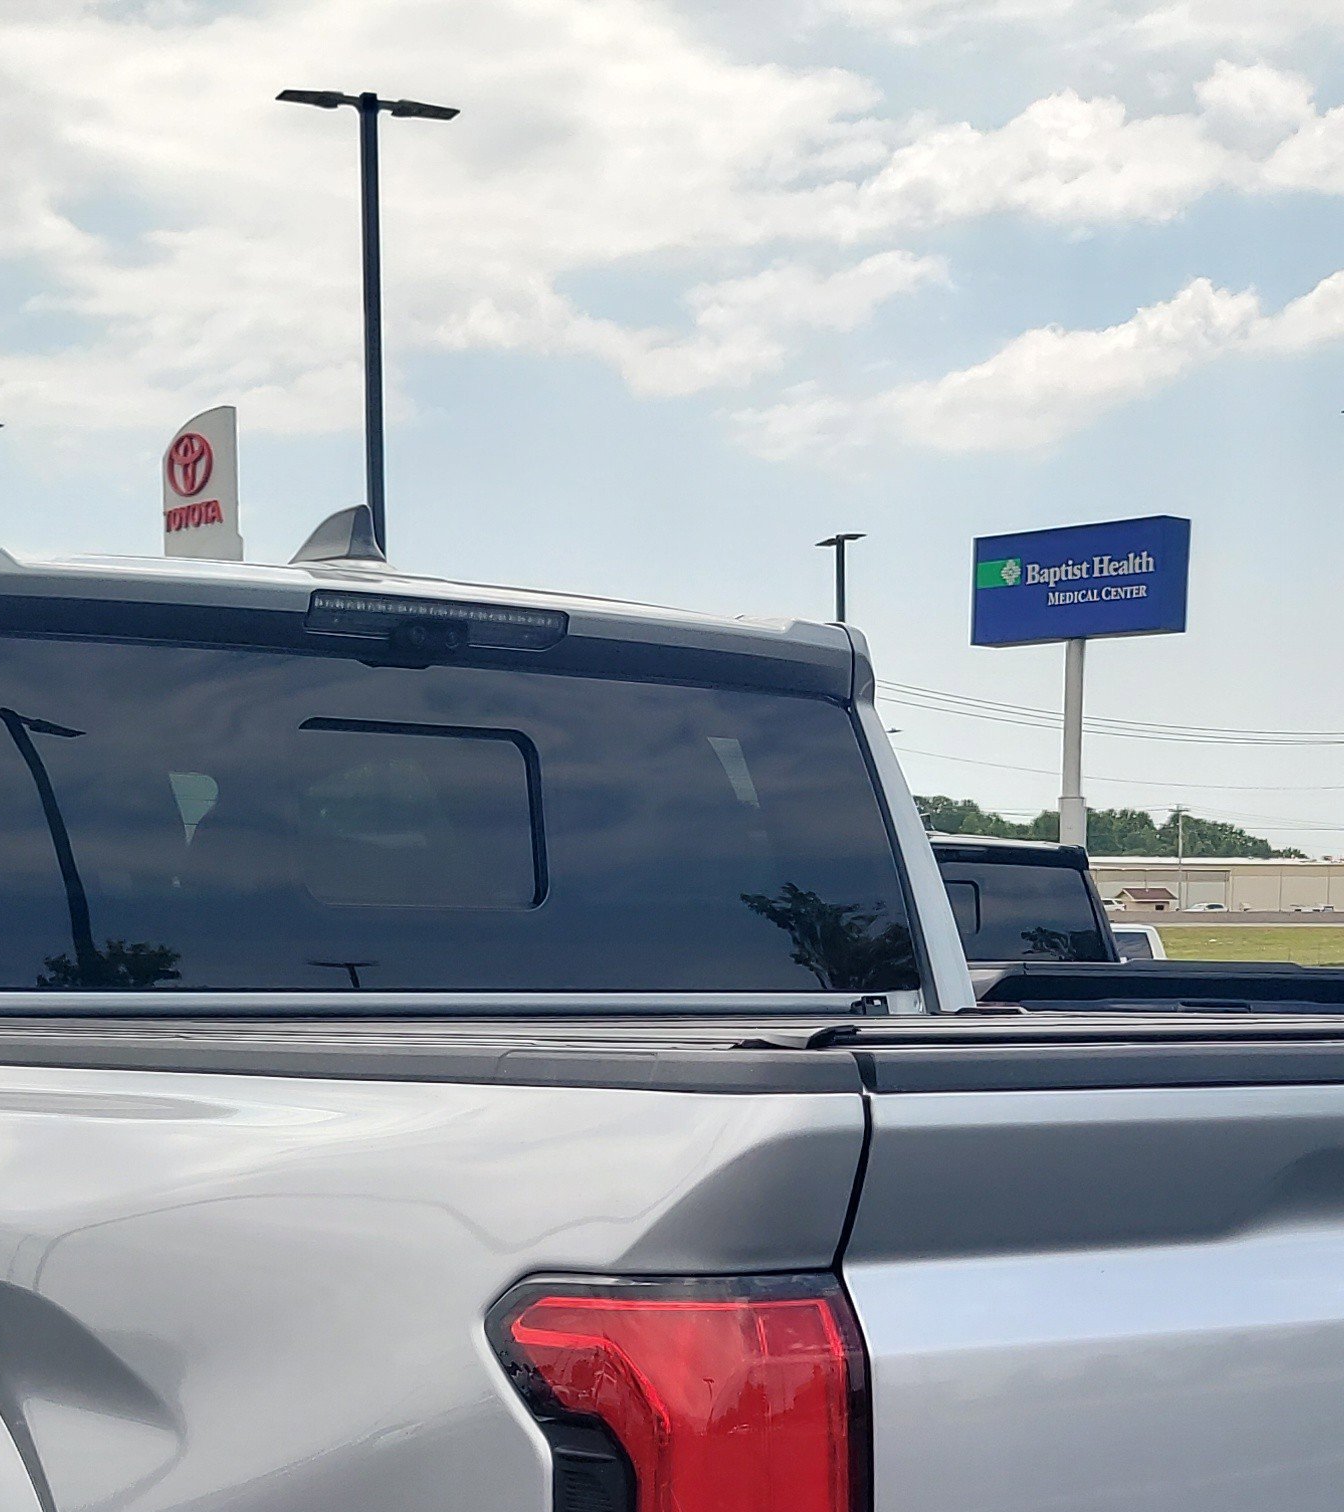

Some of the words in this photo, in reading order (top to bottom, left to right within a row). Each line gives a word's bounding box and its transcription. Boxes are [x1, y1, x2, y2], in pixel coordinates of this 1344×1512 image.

[163, 499, 223, 532] TOYOTA
[1026, 559, 1090, 587] Baptist
[1092, 551, 1155, 578] Health
[1047, 590, 1100, 606] MEDICAL
[1102, 585, 1147, 601] CENTER
